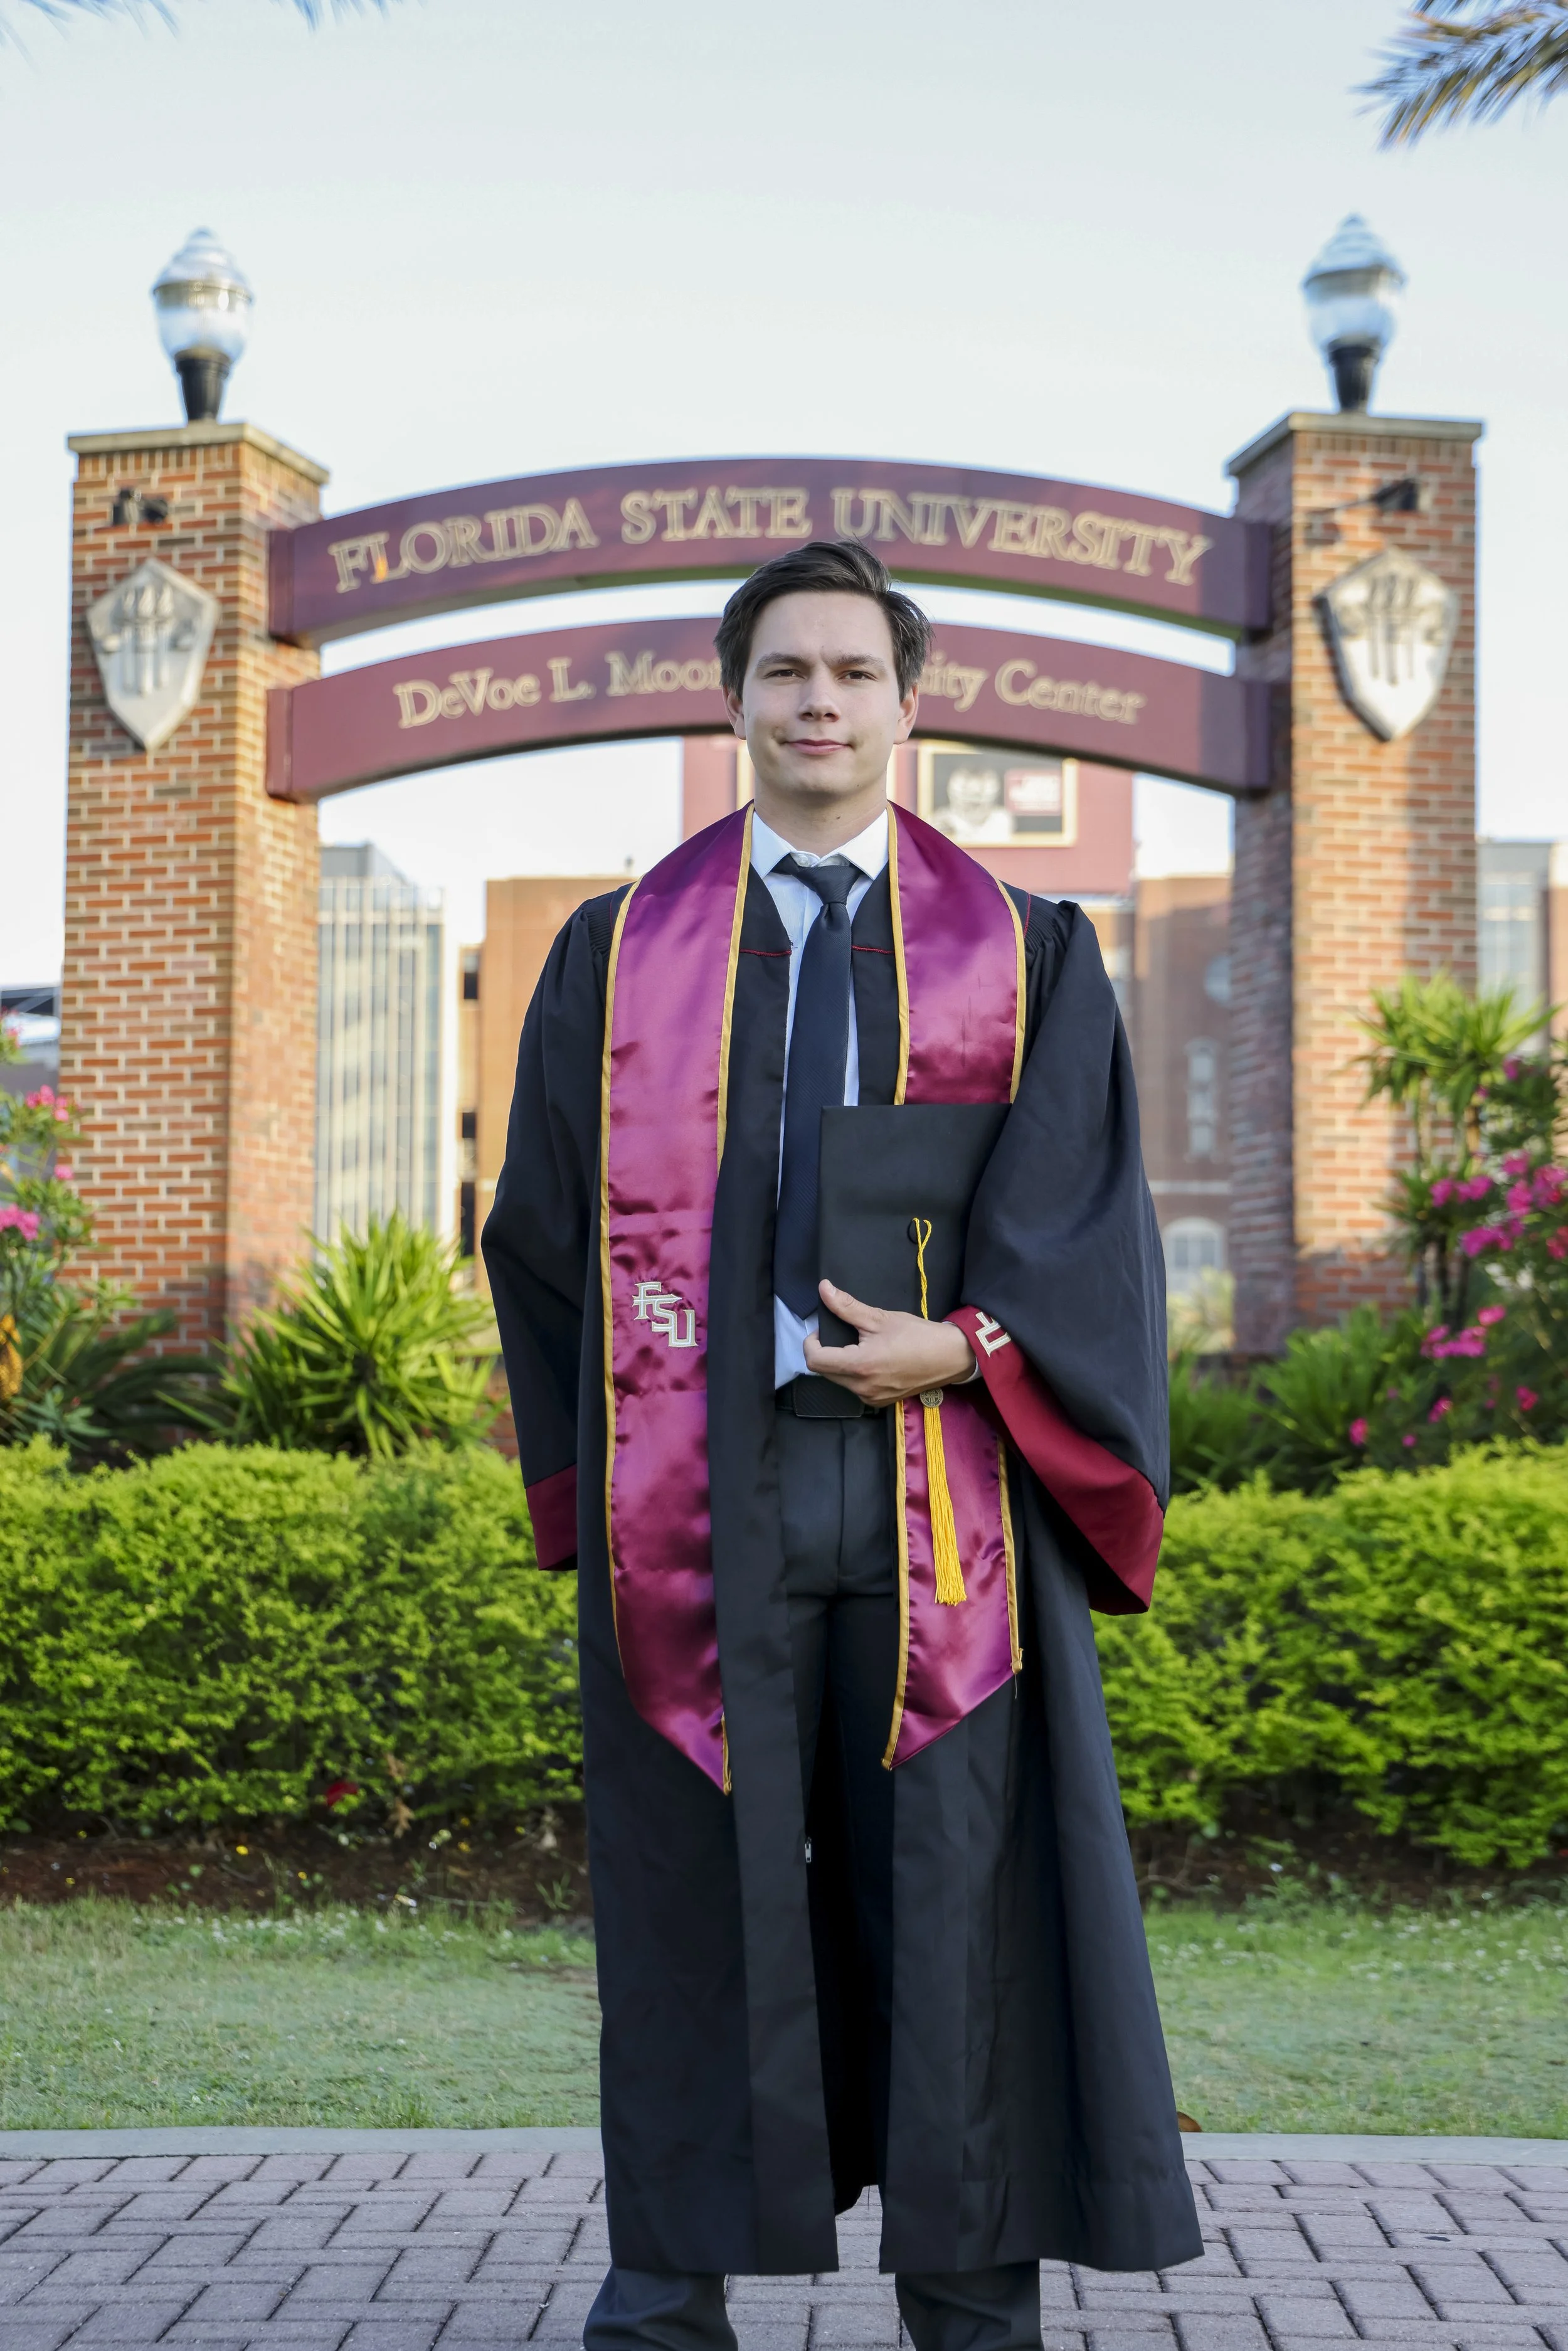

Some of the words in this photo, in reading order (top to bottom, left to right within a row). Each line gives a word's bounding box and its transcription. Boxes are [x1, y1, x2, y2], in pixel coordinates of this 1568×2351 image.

[329, 497, 600, 593] FLORIDA
[621, 486, 813, 544] STATE
[832, 487, 1214, 586] UNIVERSITY
[393, 667, 542, 730] DeVoe
[547, 657, 596, 703] L.
[995, 659, 1145, 724] Center
[632, 1282, 699, 1347] FSU
